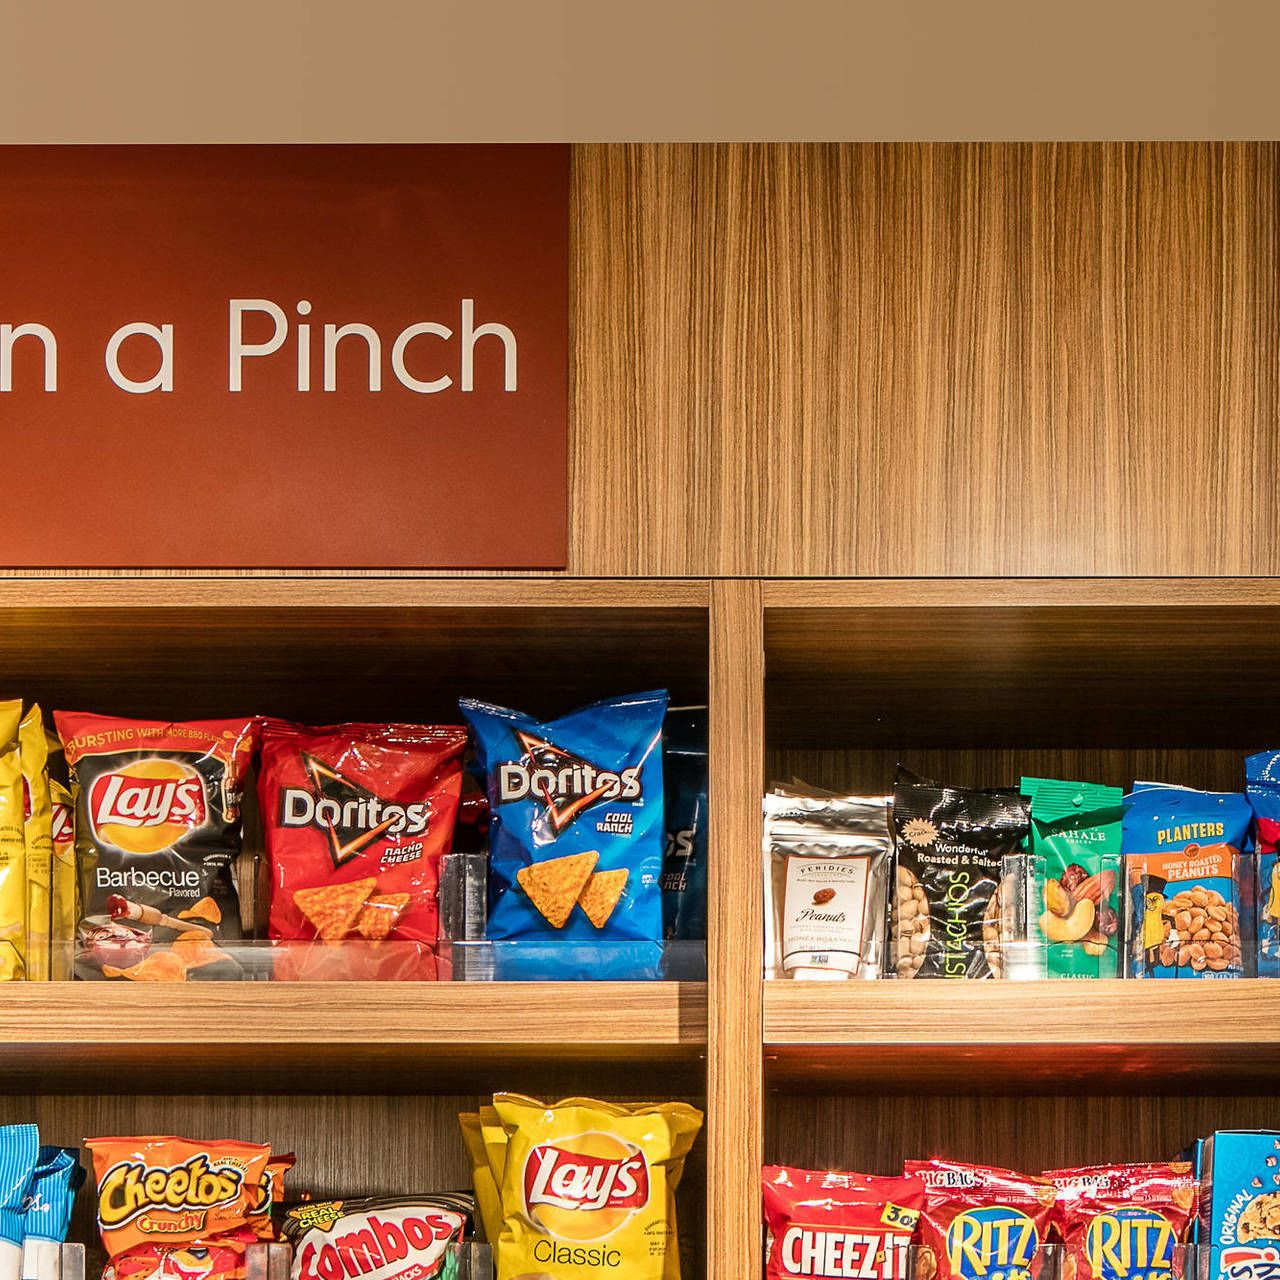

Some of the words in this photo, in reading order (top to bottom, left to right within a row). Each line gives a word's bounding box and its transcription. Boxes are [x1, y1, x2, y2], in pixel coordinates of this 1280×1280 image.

[105, 321, 174, 394] a
[228, 298, 518, 394] Pinch
[498, 762, 643, 803] Doritos
[96, 775, 200, 828] Lay's
[282, 788, 430, 835] Doritos
[596, 822, 634, 835] RANCH
[604, 811, 634, 824] COOL
[1156, 822, 1225, 846] PLANTERS
[379, 851, 424, 865] CHEESE
[383, 842, 424, 857] NACHO
[917, 853, 958, 866] Roasted
[960, 855, 971, 865] &
[96, 867, 200, 889] Barbecue
[1167, 863, 1219, 881] PEANUTS
[168, 887, 201, 899] Flavored
[795, 908, 847, 923] Peanuts
[99, 1154, 242, 1224] Cheetos
[528, 1147, 643, 1212] Lay's
[135, 1208, 207, 1233] Crunchy
[300, 1206, 339, 1222] REAL
[885, 1207, 900, 1222] 3
[1220, 1188, 1254, 1245] ORIGINAL
[532, 1239, 622, 1269] Classic
[950, 1214, 1037, 1277] RITZ
[1091, 1214, 1173, 1279] RITZ
